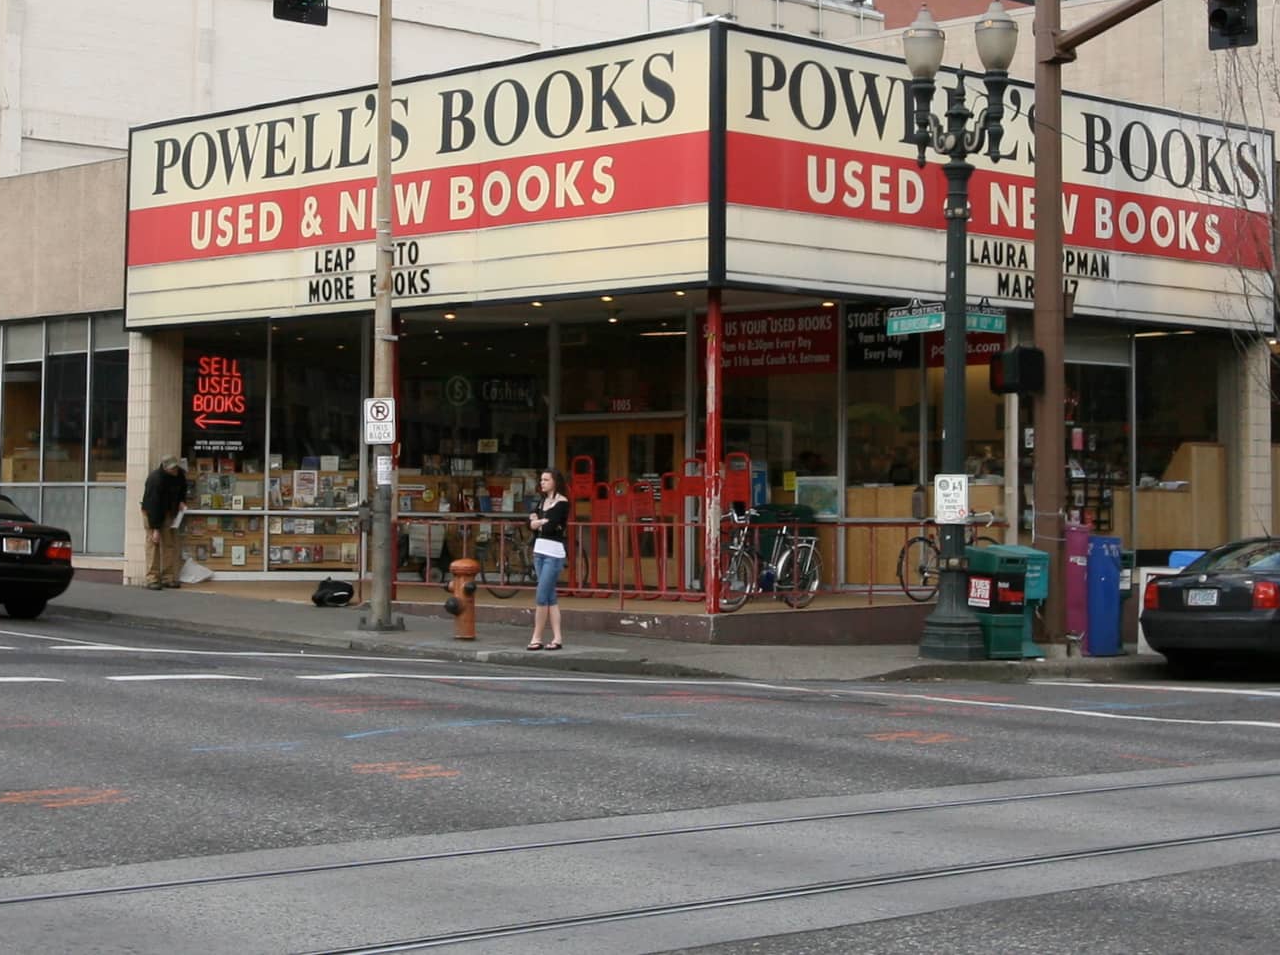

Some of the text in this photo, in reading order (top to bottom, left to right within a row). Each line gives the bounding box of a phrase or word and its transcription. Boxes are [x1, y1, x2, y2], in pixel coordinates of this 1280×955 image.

[152, 49, 676, 196] POWELL'S BOOKS
[1081, 112, 1260, 199] BOOKS
[190, 200, 283, 250] USED
[300, 196, 323, 238] &
[449, 155, 615, 221] BOOKS
[806, 154, 924, 215] USED
[1095, 197, 1221, 255] BOOKS
[314, 247, 356, 274] LEAP
[969, 238, 1028, 269] LAURA
[308, 268, 431, 303] MORE BOKS
[724, 320, 738, 336] US
[741, 318, 768, 336] YOUR
[770, 317, 796, 334] USED
[798, 315, 833, 331] BOOKS
[848, 310, 880, 328] STORE
[889, 309, 910, 318] PEARL
[911, 306, 943, 316] DISTRICT
[198, 356, 241, 376] SELL
[197, 376, 242, 395] USED
[193, 393, 245, 414] BOOKS
